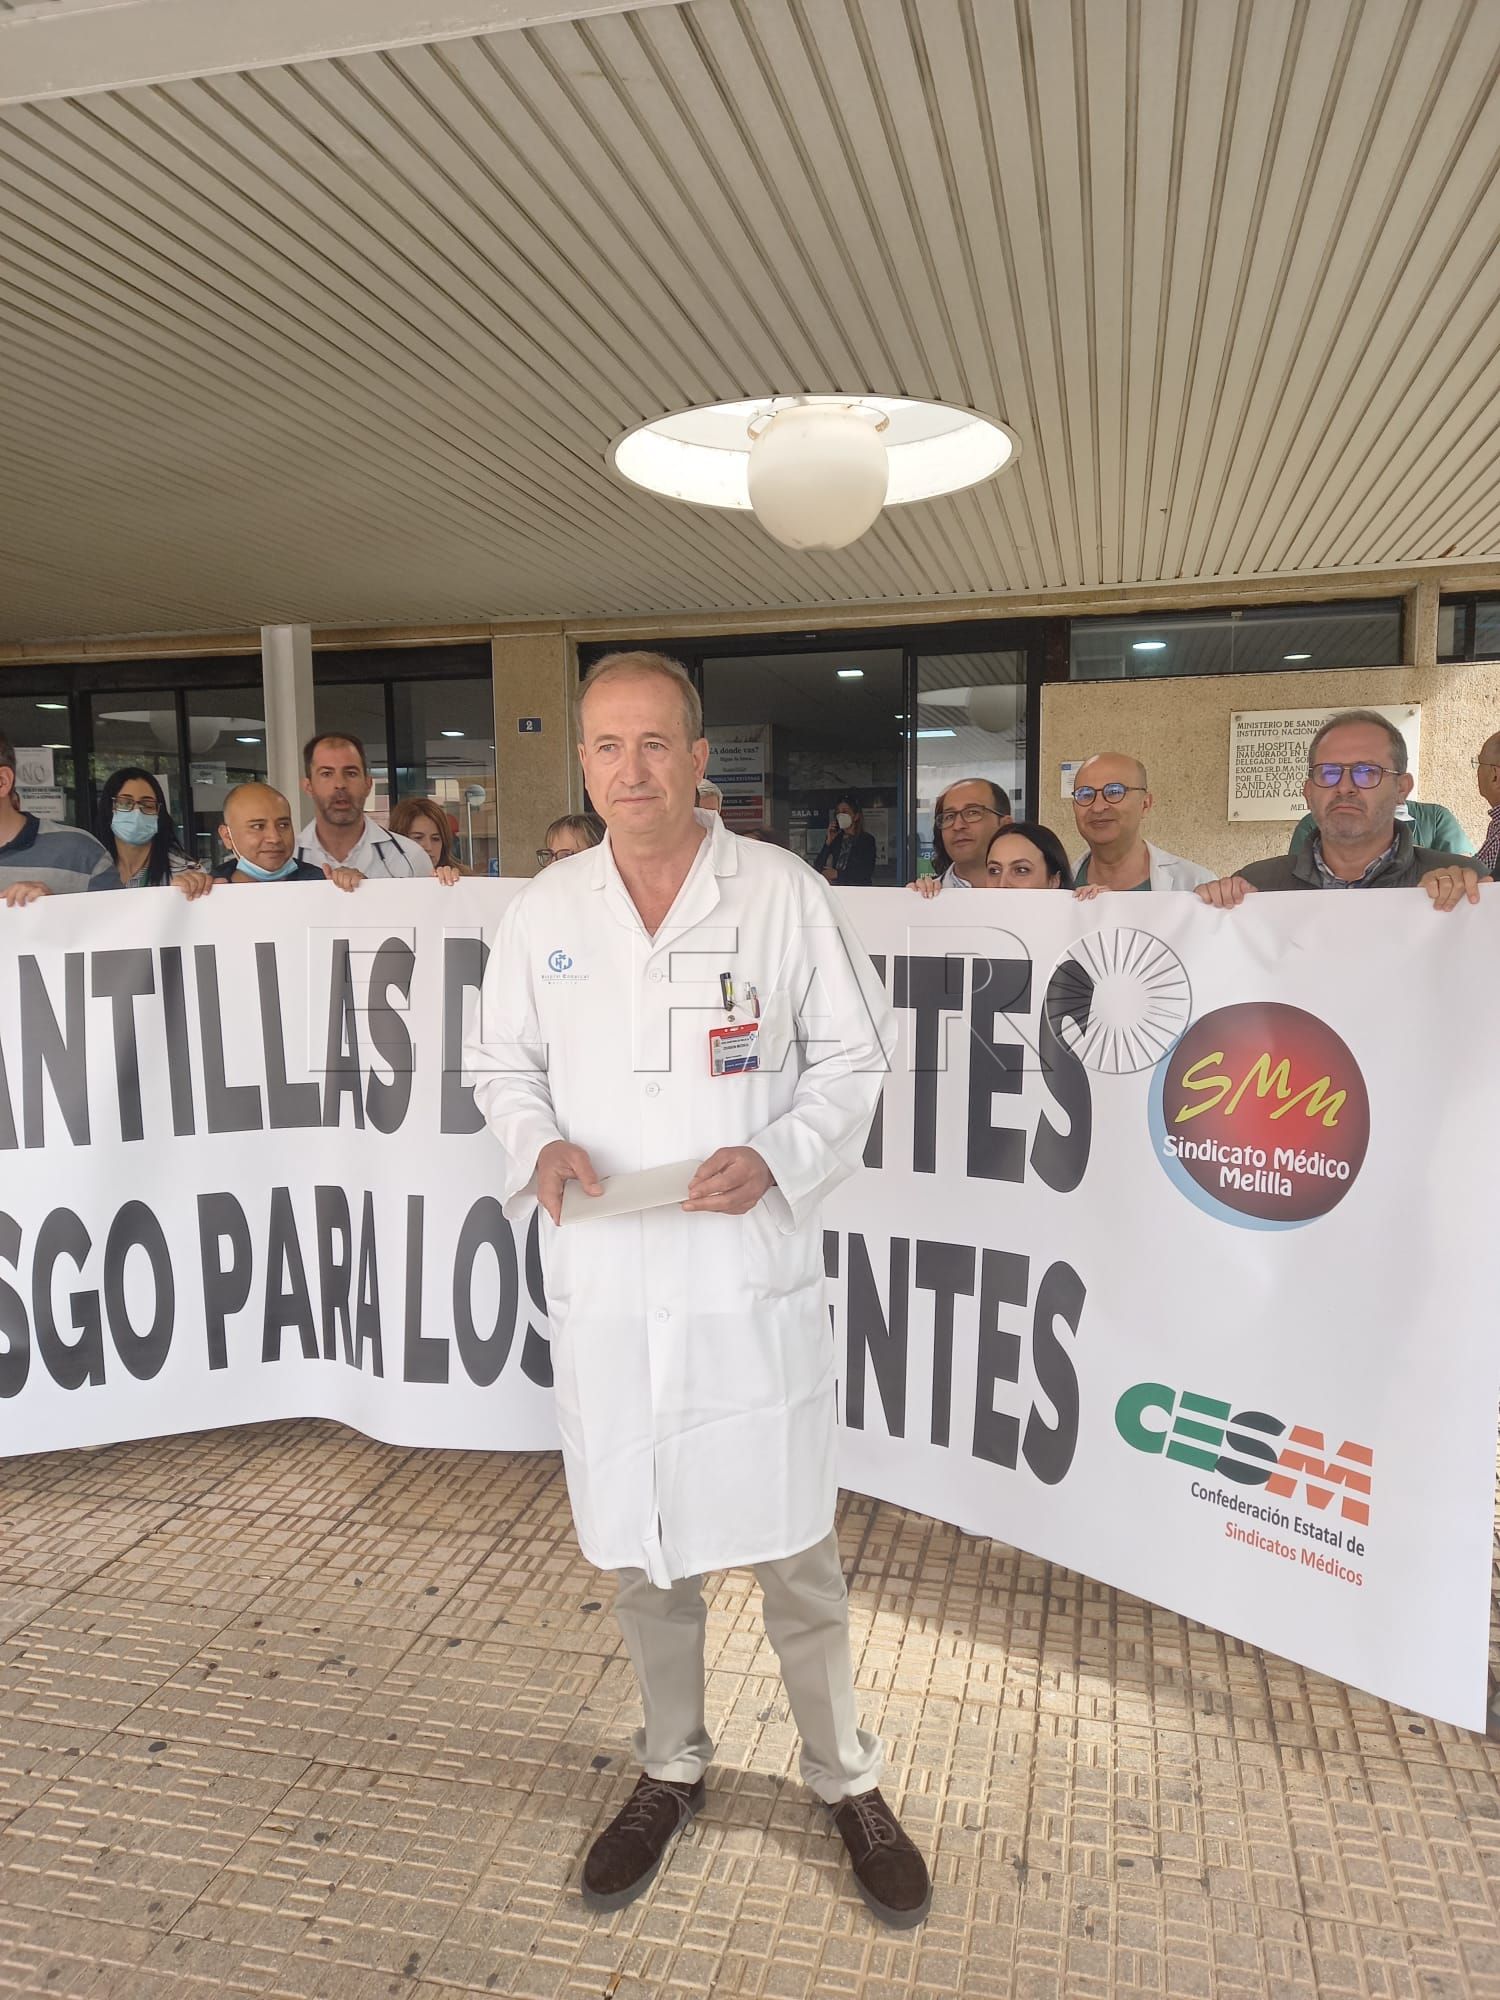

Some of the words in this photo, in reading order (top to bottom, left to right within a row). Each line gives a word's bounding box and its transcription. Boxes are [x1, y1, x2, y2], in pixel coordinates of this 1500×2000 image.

[526, 720, 533, 731] 2
[1236, 721, 1283, 730] MINISTERIO
[1284, 720, 1294, 728] DE
[1236, 729, 1279, 737] INSTITUTO
[1281, 728, 1318, 736] NACIONA
[1236, 744, 1255, 752] ESTE
[1257, 741, 1308, 751] HOSPITAL
[1236, 750, 1288, 759] INAUGURADO
[1290, 749, 1301, 757] EN
[1235, 757, 1276, 766] DELEGADO
[1278, 756, 1292, 764] DEL
[1254, 774, 1264, 782] EL
[1235, 780, 1282, 791] SANIDAD
[1284, 781, 1292, 789] Y
[1290, 803, 1307, 811] MEL
[0, 937, 417, 1150] NTILLAS
[1174, 1051, 1347, 1127] SMM
[1162, 1135, 1267, 1168] Sindicato
[1273, 1147, 1350, 1180] Médico
[1219, 1165, 1293, 1197] Melilla
[197, 1185, 385, 1379] PARA
[1114, 1382, 1374, 1527] CESM
[1191, 1481, 1290, 1529] Confederación
[1294, 1516, 1343, 1548] Estatal
[1346, 1536, 1365, 1557] de
[1225, 1521, 1297, 1561] Sindicatos
[1301, 1548, 1363, 1587] Médicos
